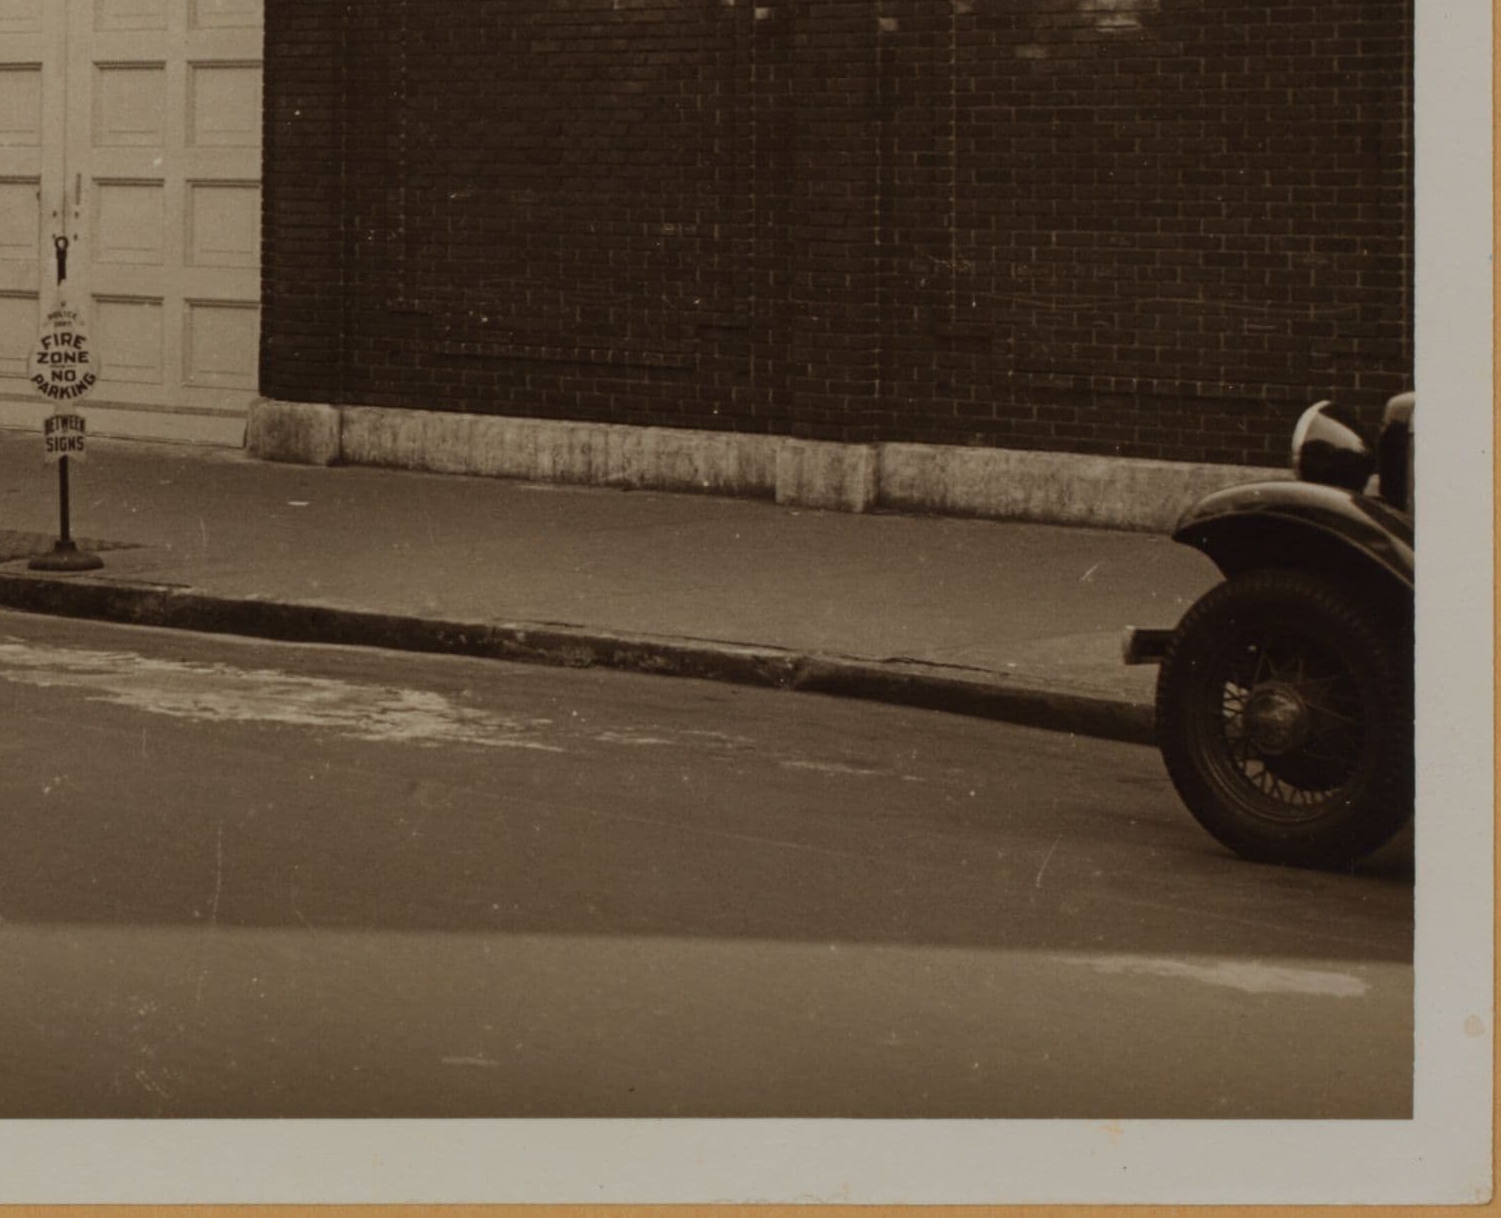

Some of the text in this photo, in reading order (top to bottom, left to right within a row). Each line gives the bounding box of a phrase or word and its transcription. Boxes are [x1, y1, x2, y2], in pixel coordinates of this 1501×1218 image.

[41, 332, 87, 350] FIRE
[37, 351, 90, 364] ZONE
[51, 369, 77, 382] NO
[31, 372, 97, 399] PARKING
[44, 413, 86, 435] BETWEEN
[46, 436, 85, 452] SIGNS
